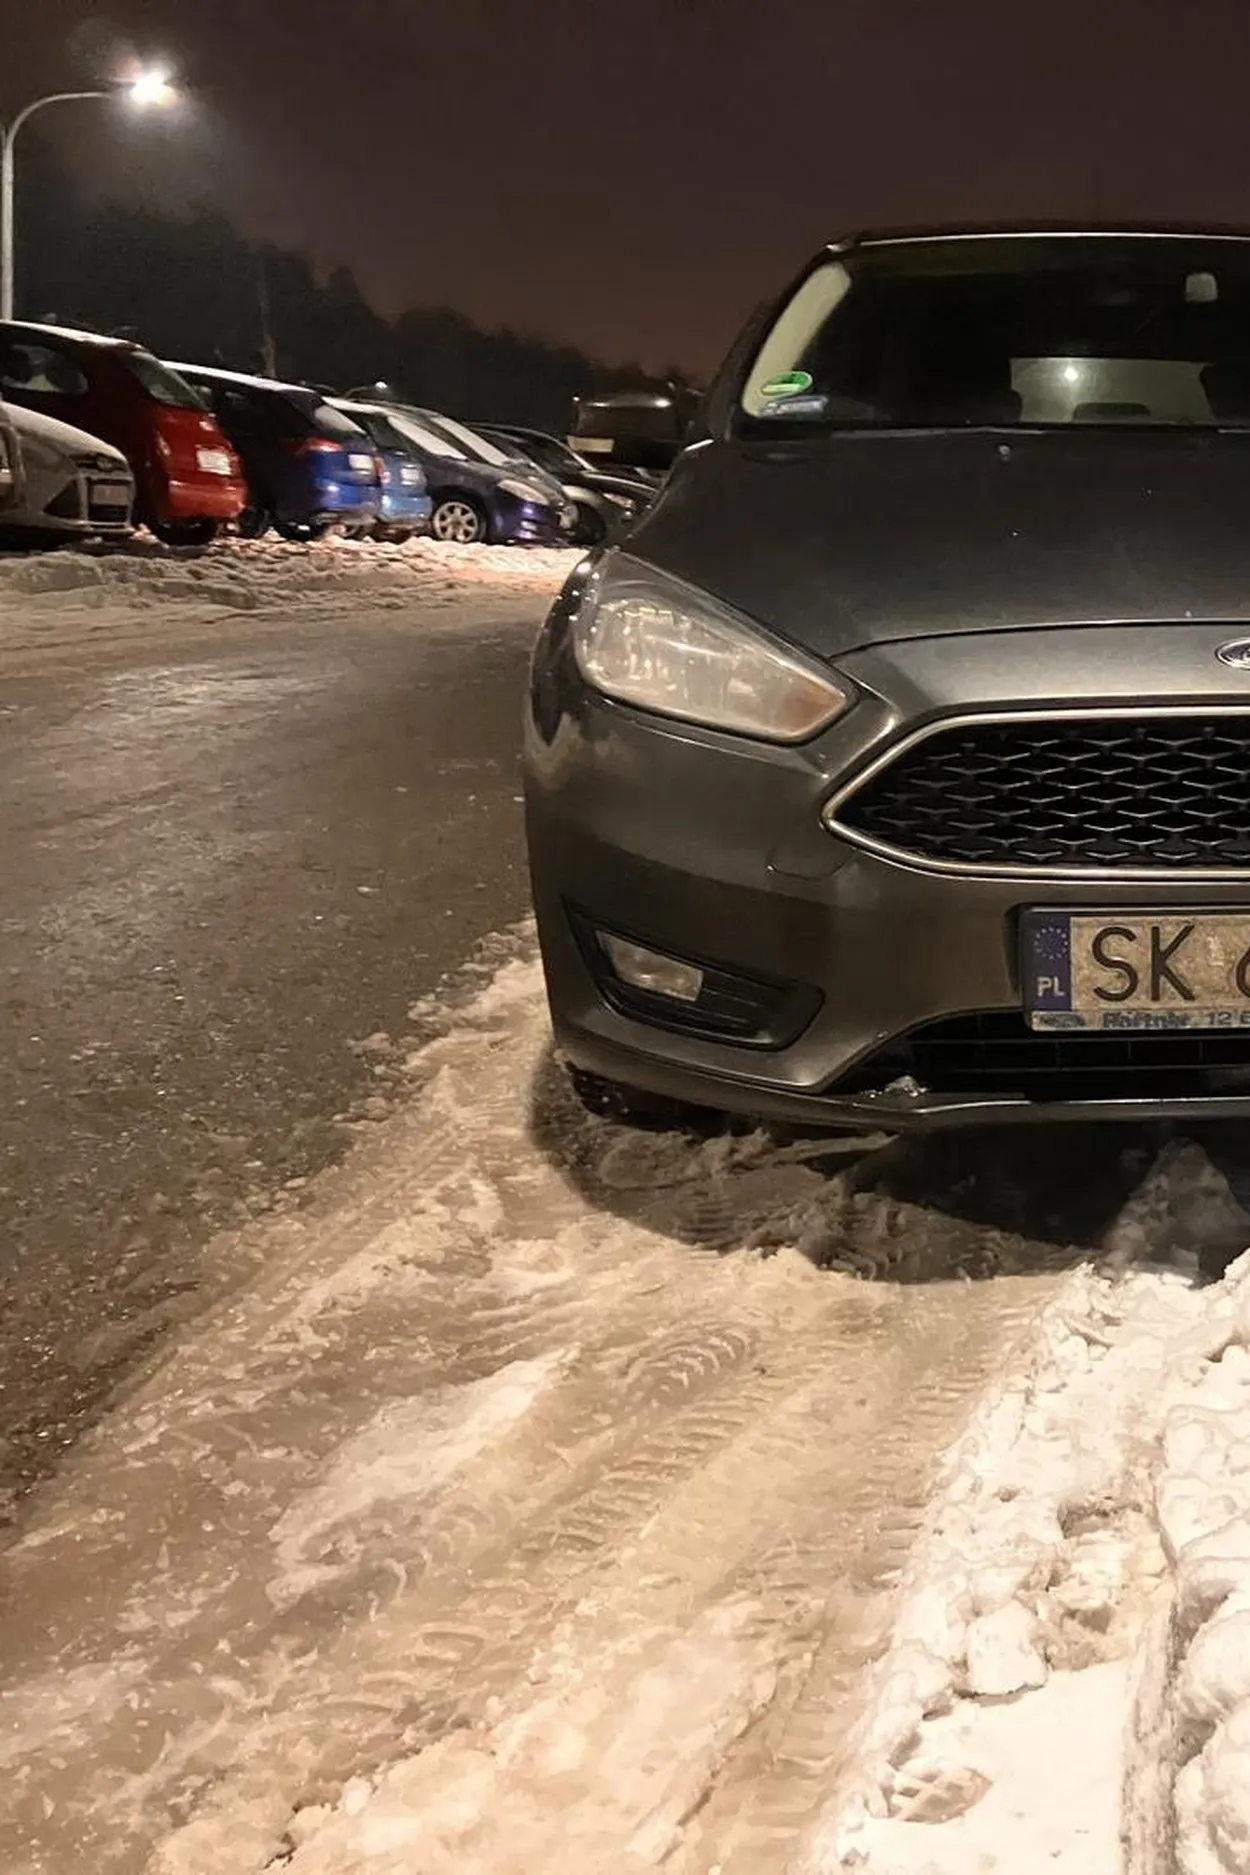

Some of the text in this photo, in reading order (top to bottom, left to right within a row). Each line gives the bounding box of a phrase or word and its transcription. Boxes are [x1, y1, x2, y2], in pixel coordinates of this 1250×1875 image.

[1091, 922, 1196, 1001] SK
[1037, 976, 1066, 997] PL
[1208, 1010, 1233, 1026] 12
